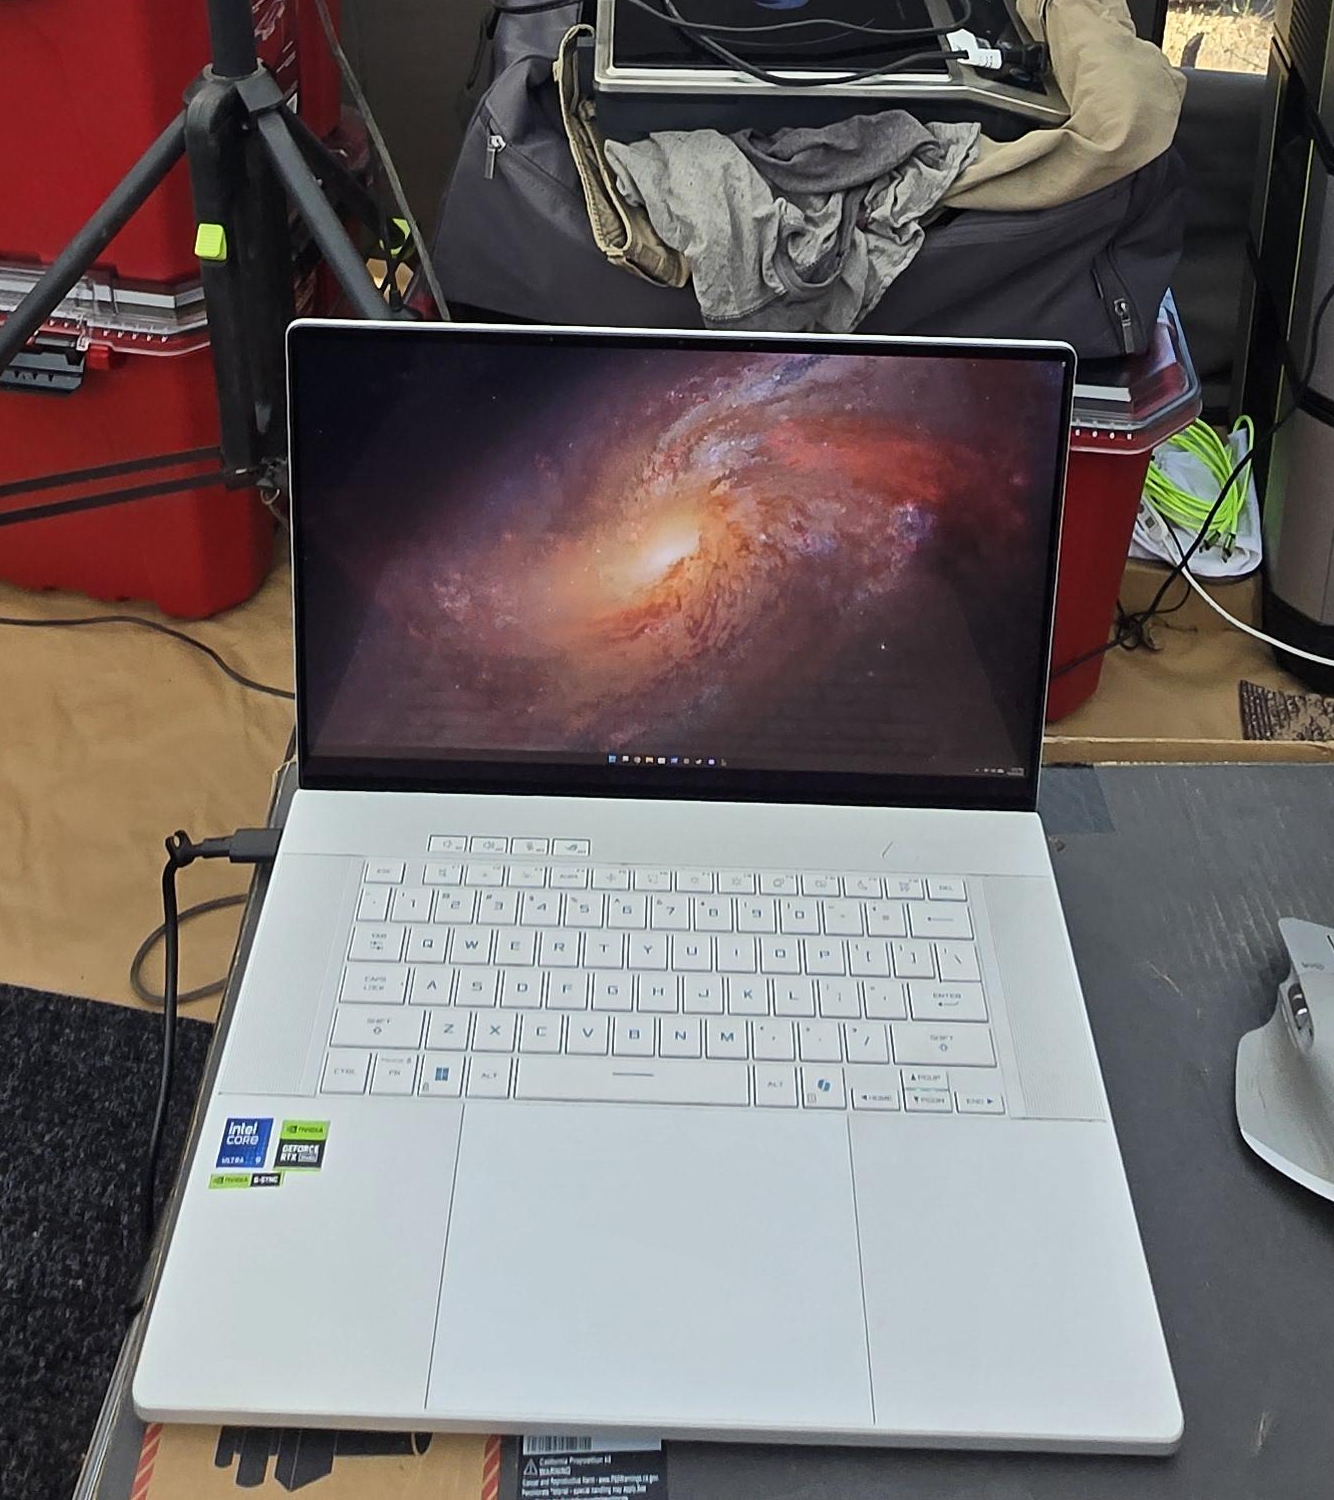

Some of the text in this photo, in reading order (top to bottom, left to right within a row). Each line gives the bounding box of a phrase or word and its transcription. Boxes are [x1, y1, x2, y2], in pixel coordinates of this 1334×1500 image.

[422, 939, 433, 949] Q
[465, 940, 479, 950] W
[510, 941, 520, 951] E
[554, 942, 565, 952] R
[598, 944, 609, 953] T
[643, 945, 653, 954] Y
[686, 946, 698, 956] U
[820, 950, 830, 959] P
[426, 980, 438, 990] A
[471, 982, 483, 992] S
[517, 983, 528, 993] D
[562, 984, 573, 994] F
[607, 985, 619, 996] G
[652, 987, 664, 997] H
[698, 989, 709, 998] J
[743, 990, 753, 999] K
[788, 991, 799, 1000] L
[443, 1024, 454, 1034] Z
[490, 1025, 501, 1035] X
[536, 1027, 547, 1037] C
[582, 1028, 594, 1038] V
[629, 1029, 640, 1039] B
[675, 1031, 687, 1041] N
[720, 1032, 735, 1042] M
[229, 1121, 259, 1136] intel
